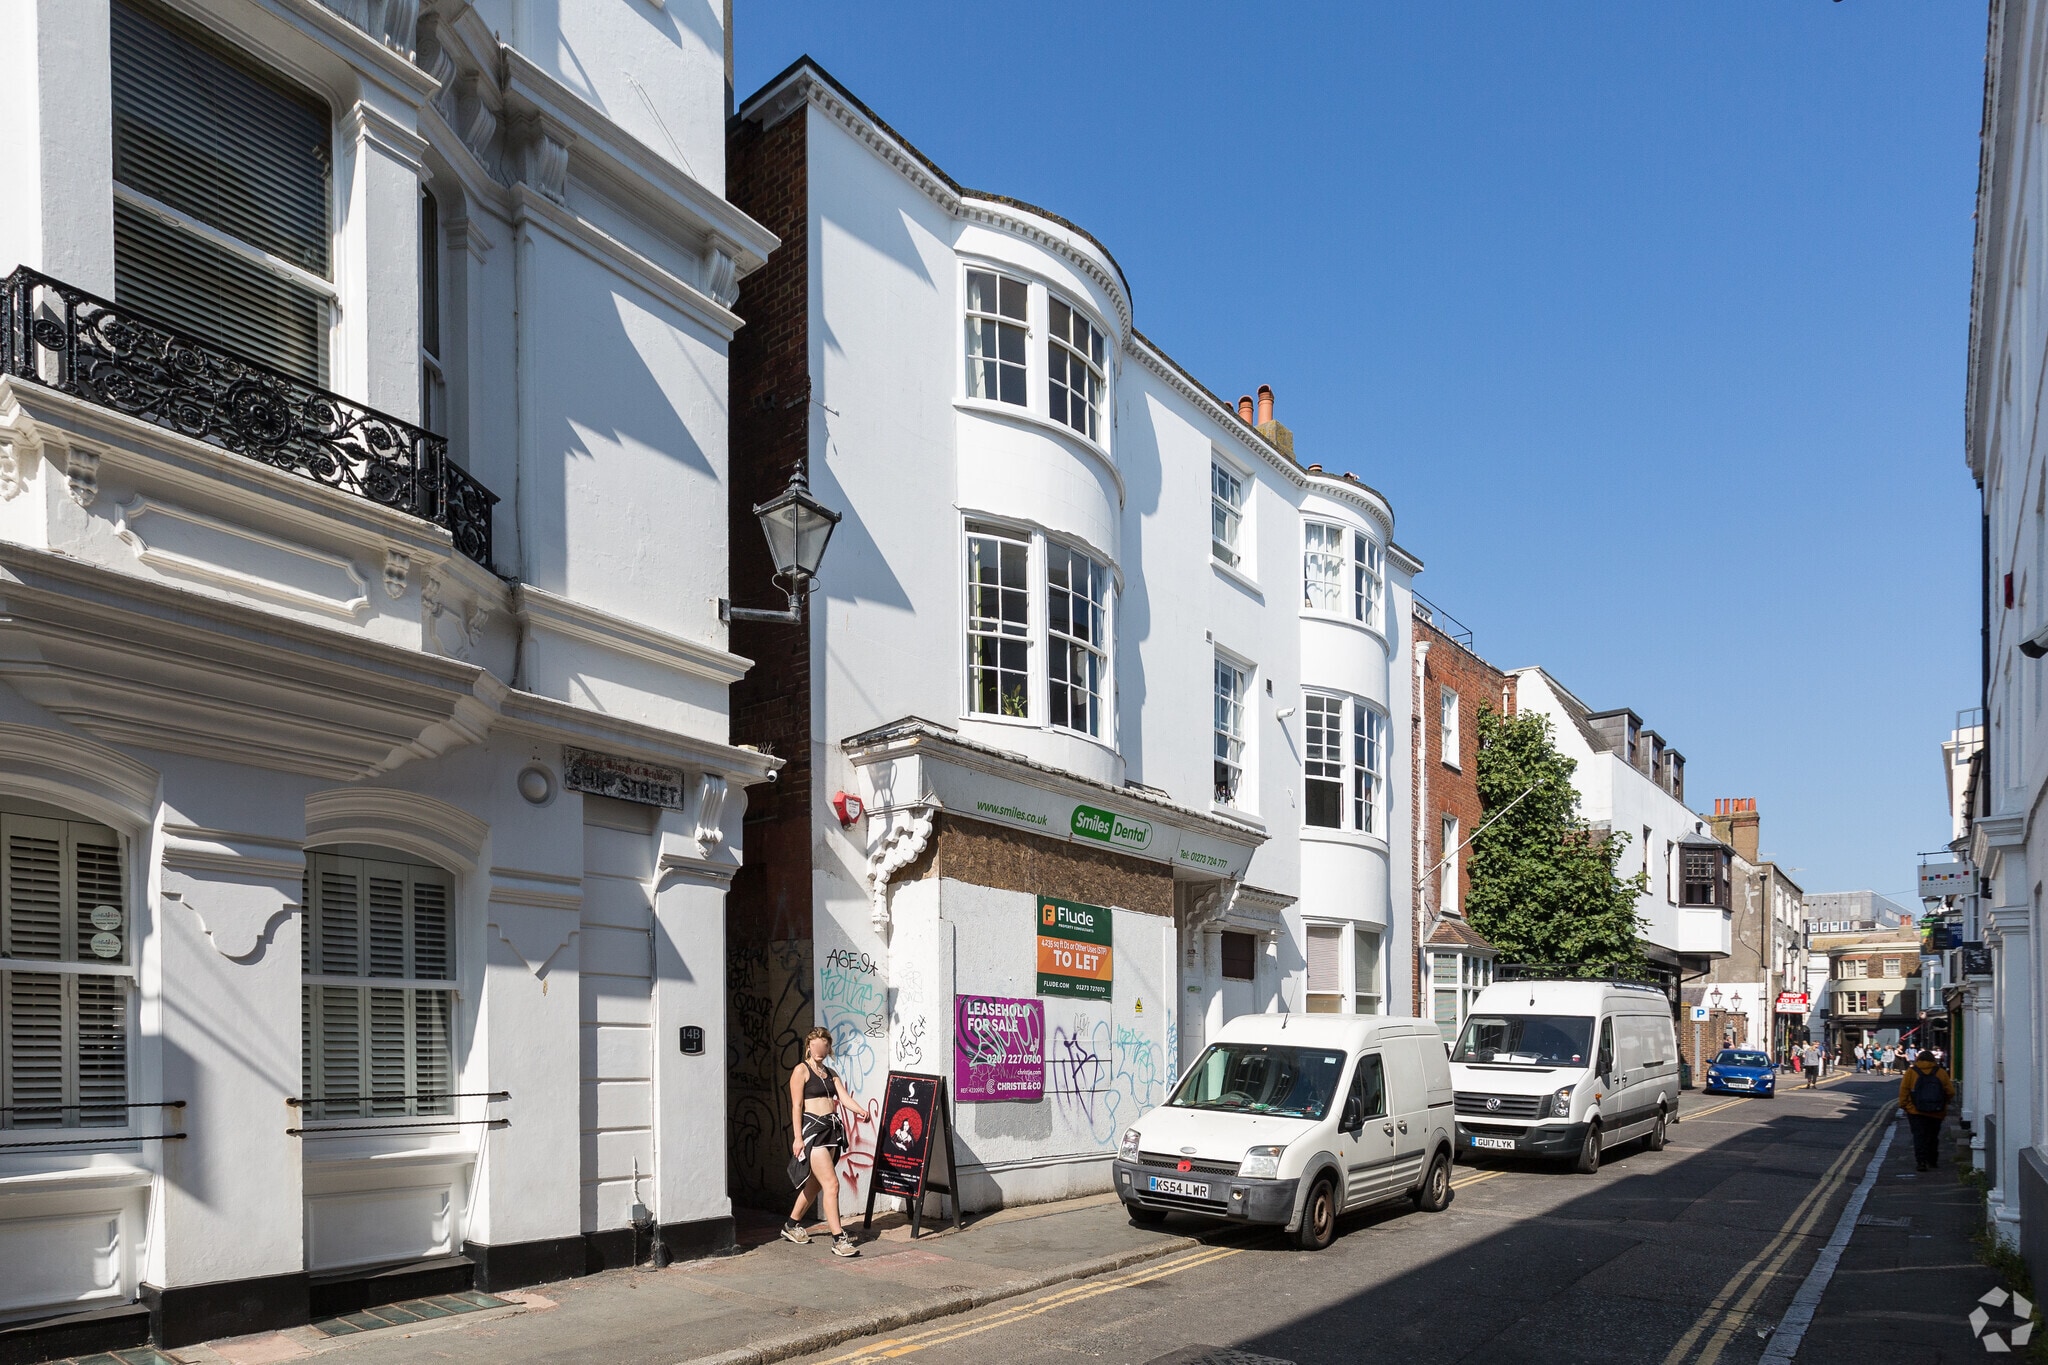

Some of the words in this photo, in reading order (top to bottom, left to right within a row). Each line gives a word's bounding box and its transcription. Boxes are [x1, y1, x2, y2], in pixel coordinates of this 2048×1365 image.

[620, 778, 680, 805] STREET
[976, 801, 1048, 826] www.smiles.co.uk
[1075, 811, 1110, 835] Smiles
[1113, 821, 1148, 843] Dental
[1190, 852, 1207, 864] 01273
[1207, 855, 1217, 867] 724
[1217, 858, 1228, 869] 777
[1057, 906, 1094, 927] Flude
[1053, 949, 1072, 968] TO
[1075, 953, 1099, 971] LET
[1043, 980, 1070, 989] FLUDE.COM
[1075, 984, 1089, 992] 01273
[967, 1001, 1031, 1018] LEASEHOLD
[1696, 1009, 1705, 1018] P
[682, 1028, 701, 1039] 14B
[967, 1017, 991, 1031] FOR
[991, 1018, 1018, 1033] SALE
[1007, 1054, 1022, 1064] 227
[1496, 1140, 1512, 1148] LYK
[1156, 1179, 1183, 1193] KS54
[1185, 1183, 1207, 1197] LWR
